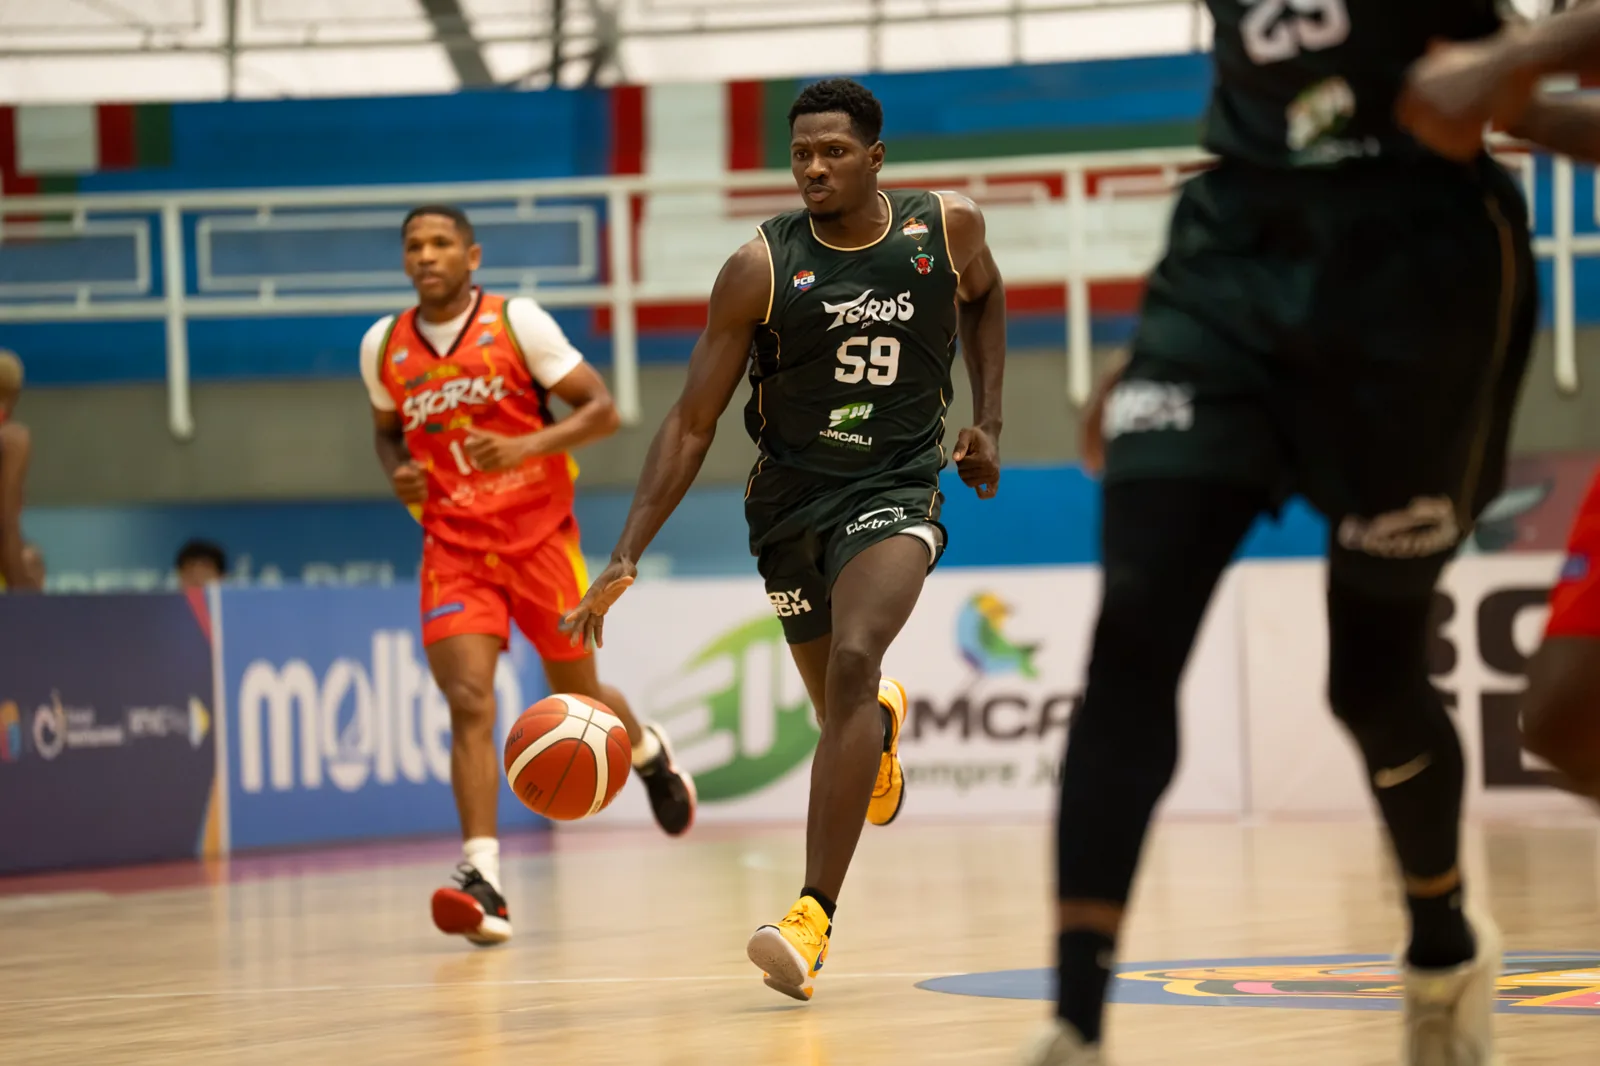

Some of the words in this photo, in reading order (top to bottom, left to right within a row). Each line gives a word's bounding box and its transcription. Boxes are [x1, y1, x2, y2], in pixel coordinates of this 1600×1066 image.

[793, 275, 815, 288] FCB
[821, 288, 915, 332] TOROS
[834, 336, 901, 386] 59
[402, 375, 507, 432] STORM
[902, 690, 1085, 742] MCA
